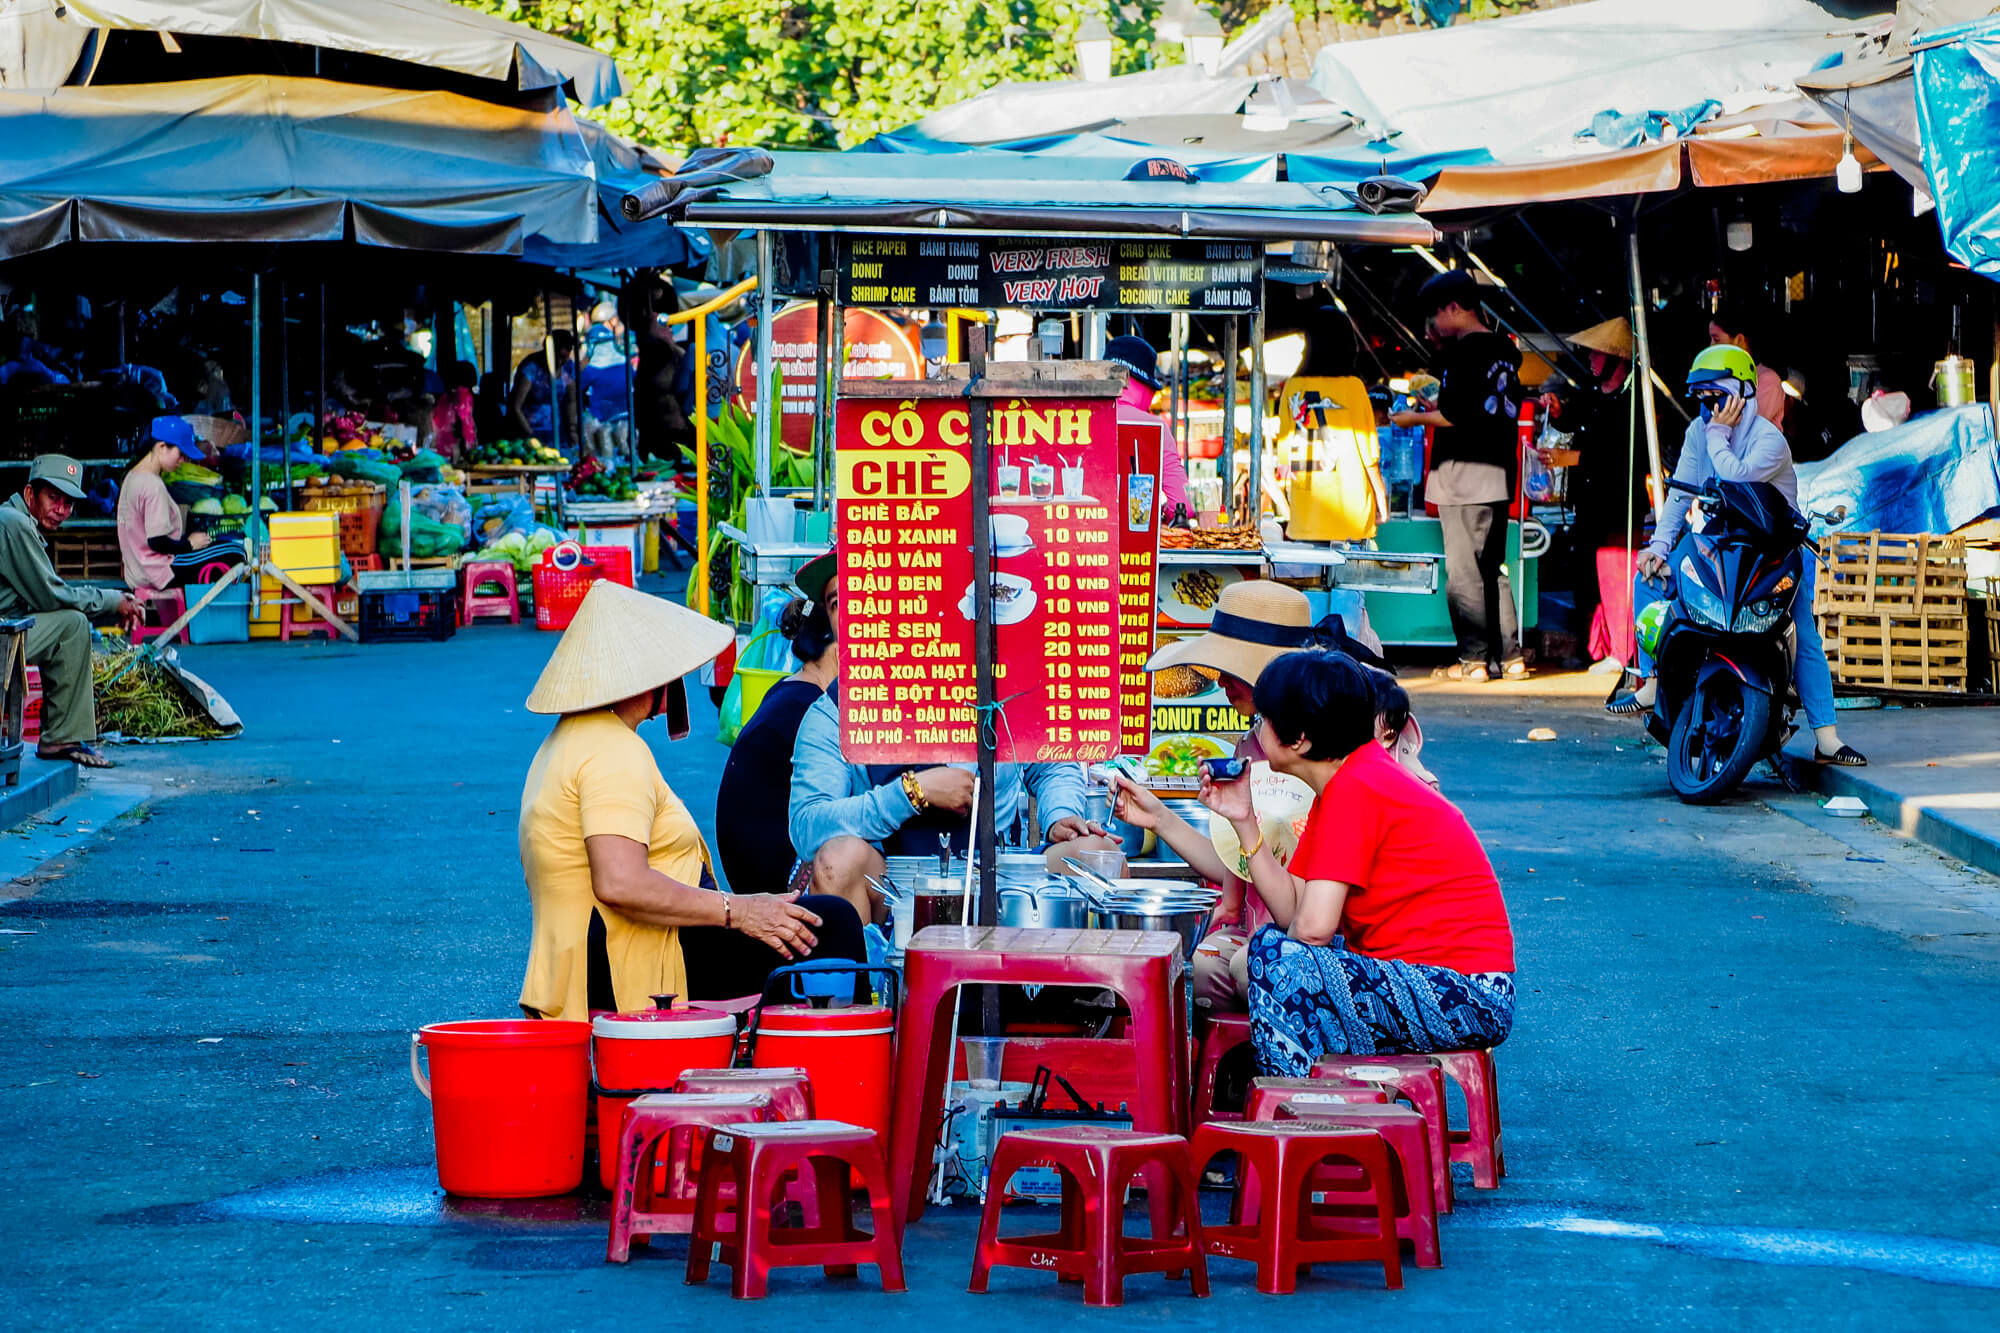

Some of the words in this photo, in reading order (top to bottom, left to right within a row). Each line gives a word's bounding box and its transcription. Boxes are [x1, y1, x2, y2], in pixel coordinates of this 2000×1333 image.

[852, 240, 874, 255] RICE
[876, 241, 906, 256] PAPER
[920, 239, 945, 256] BÁNH
[1120, 243, 1144, 258] CRAB
[1147, 244, 1171, 259] CAKE
[1206, 242, 1232, 259] BÁNH
[1235, 244, 1252, 259] CUA
[990, 249, 1043, 273] VERY
[1046, 246, 1111, 269] FRESH
[852, 263, 883, 279] DONUT
[948, 264, 979, 280] DONUT
[1120, 265, 1150, 281] BREAD
[1153, 266, 1177, 281] WITH
[1180, 266, 1205, 281] MEAT
[1212, 264, 1237, 282] BÁNH
[851, 285, 889, 302] SHRIMP
[891, 286, 916, 303] CAKE
[929, 284, 956, 303] BÁNH
[958, 285, 979, 303] TÔM
[1003, 280, 1057, 303] VERY
[1060, 276, 1105, 300] HOT
[1120, 289, 1162, 305] COCONUT
[1165, 289, 1190, 305] CAKE
[1204, 287, 1230, 305] BÁNH
[1233, 287, 1252, 306] DỪA
[852, 453, 947, 495] CHÈ
[847, 502, 889, 521] CHÈ
[896, 500, 940, 521] BẮP
[1043, 504, 1069, 520] 10
[1075, 507, 1108, 519] VNĐ
[847, 526, 891, 547] ĐẬU
[898, 528, 957, 544] XANH
[1043, 528, 1070, 543] 10
[1075, 531, 1109, 543] VNĐ
[847, 549, 892, 571] ĐẬU
[898, 549, 942, 568] VÁN
[1044, 551, 1070, 567] 10
[1076, 554, 1109, 566] VNĐ
[847, 573, 892, 594] ĐẬU
[898, 575, 942, 591] ĐEN
[1044, 575, 1070, 590] 10
[1076, 578, 1109, 590] VNĐ
[847, 596, 892, 618] ĐẬU
[898, 594, 928, 615] HỦ
[1044, 598, 1071, 614] 10
[1076, 601, 1110, 613] VNĐ
[848, 620, 890, 638] CHÈ
[898, 622, 941, 638] SEN
[1044, 622, 1071, 637] 20
[1077, 624, 1110, 637] VNĐ
[848, 641, 904, 660] THẬP
[911, 639, 960, 657] CẨM
[1044, 641, 1071, 656] 20
[1077, 644, 1110, 656] VNĐ
[848, 665, 885, 679] XOA
[890, 665, 926, 679] XOA
[932, 664, 967, 681] HẠT
[1045, 663, 1071, 678] 10
[1077, 666, 1110, 678] VNĐ
[848, 684, 889, 701] CHÈ
[895, 684, 934, 703] BỘT
[940, 686, 978, 703] LỌC
[1045, 684, 1072, 700] 15
[1077, 687, 1111, 699] VNĐ
[848, 706, 878, 725] ĐẬU
[882, 704, 902, 722] ĐỎ
[916, 705, 945, 725] ĐẬU
[1045, 705, 1072, 721] 15
[1078, 708, 1111, 720] VNĐ
[1120, 714, 1145, 728] nđ
[1206, 707, 1250, 731] CAKE
[849, 728, 872, 744] TÀU
[877, 727, 903, 744] PHỚ
[914, 727, 948, 744] TRÂN
[952, 727, 978, 743] CHÂ
[1046, 727, 1072, 742] 15
[1078, 730, 1111, 742] VNĐ
[1121, 732, 1144, 746] nđ
[1109, 745, 1118, 759] !
